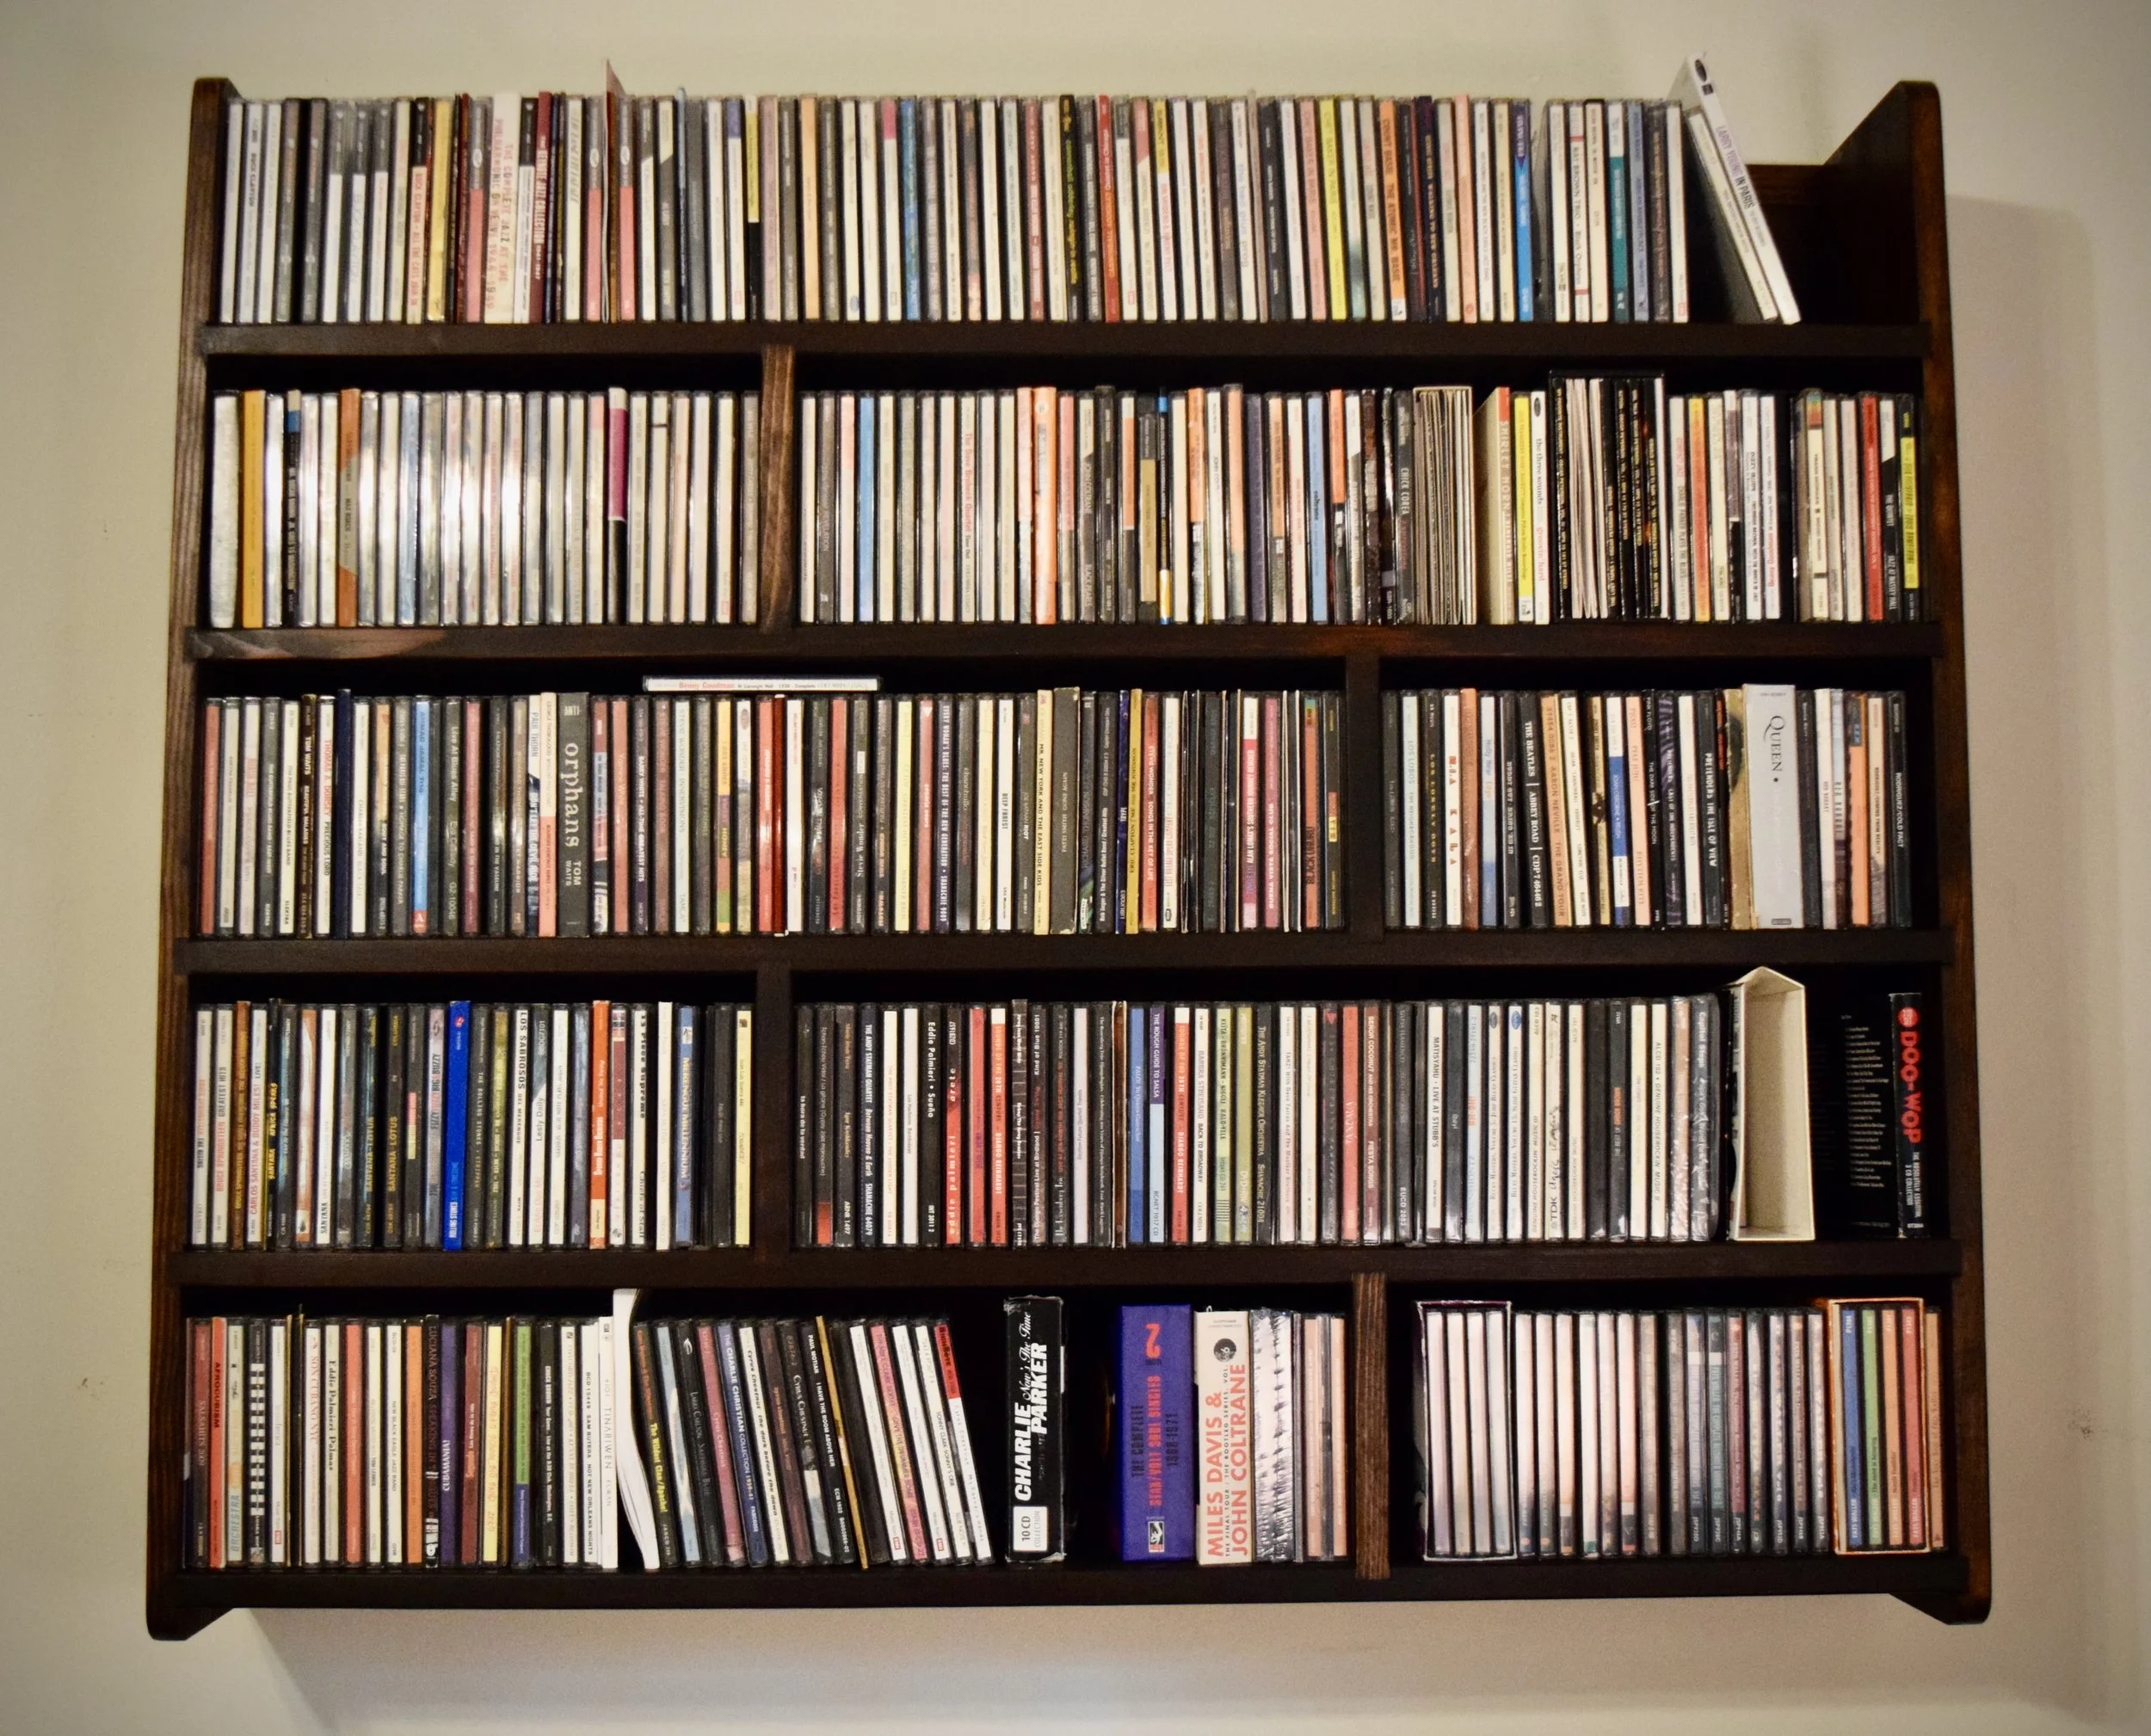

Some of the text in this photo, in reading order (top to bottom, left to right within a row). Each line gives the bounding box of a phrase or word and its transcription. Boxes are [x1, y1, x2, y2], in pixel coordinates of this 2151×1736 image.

[536, 151, 547, 179] KEYNOTE
[1716, 126, 1740, 177] LARRY YOUNG
[535, 182, 546, 199] JAZZ
[1740, 187, 1754, 209] PARIS
[533, 200, 545, 243] COLLECTION
[1501, 422, 1509, 470] SHIRLEY
[1401, 467, 1409, 515] CHICK COREA
[964, 504, 972, 532] Quartet
[451, 745, 458, 754] At
[1763, 716, 1787, 772] QUEEN
[561, 743, 582, 846] orphans
[1705, 753, 1714, 799] PRETENDERS
[448, 838, 457, 866] Cassidy
[1899, 1030, 1924, 1143] DOO-WOP
[1433, 1105, 1439, 1114] AT
[328, 1360, 336, 1388] Eddie
[726, 1347, 737, 1384] CHARLIE
[1020, 1311, 1032, 1400] Now's The Time
[731, 1386, 745, 1432] CHRISTIAN
[1031, 1342, 1047, 1434] PARKER
[328, 1390, 336, 1431] Palmieri
[739, 1433, 750, 1473] COLLECTION
[1015, 1401, 1032, 1500] CHARLIE
[1131, 1405, 1144, 1477] THE COMPLETE
[1230, 1364, 1248, 1556] JOHN COLTRANE
[745, 1474, 755, 1500] 1939-41
[1206, 1391, 1223, 1556] MILES DAVIS &
[1021, 1516, 1030, 1542] 10 CD
